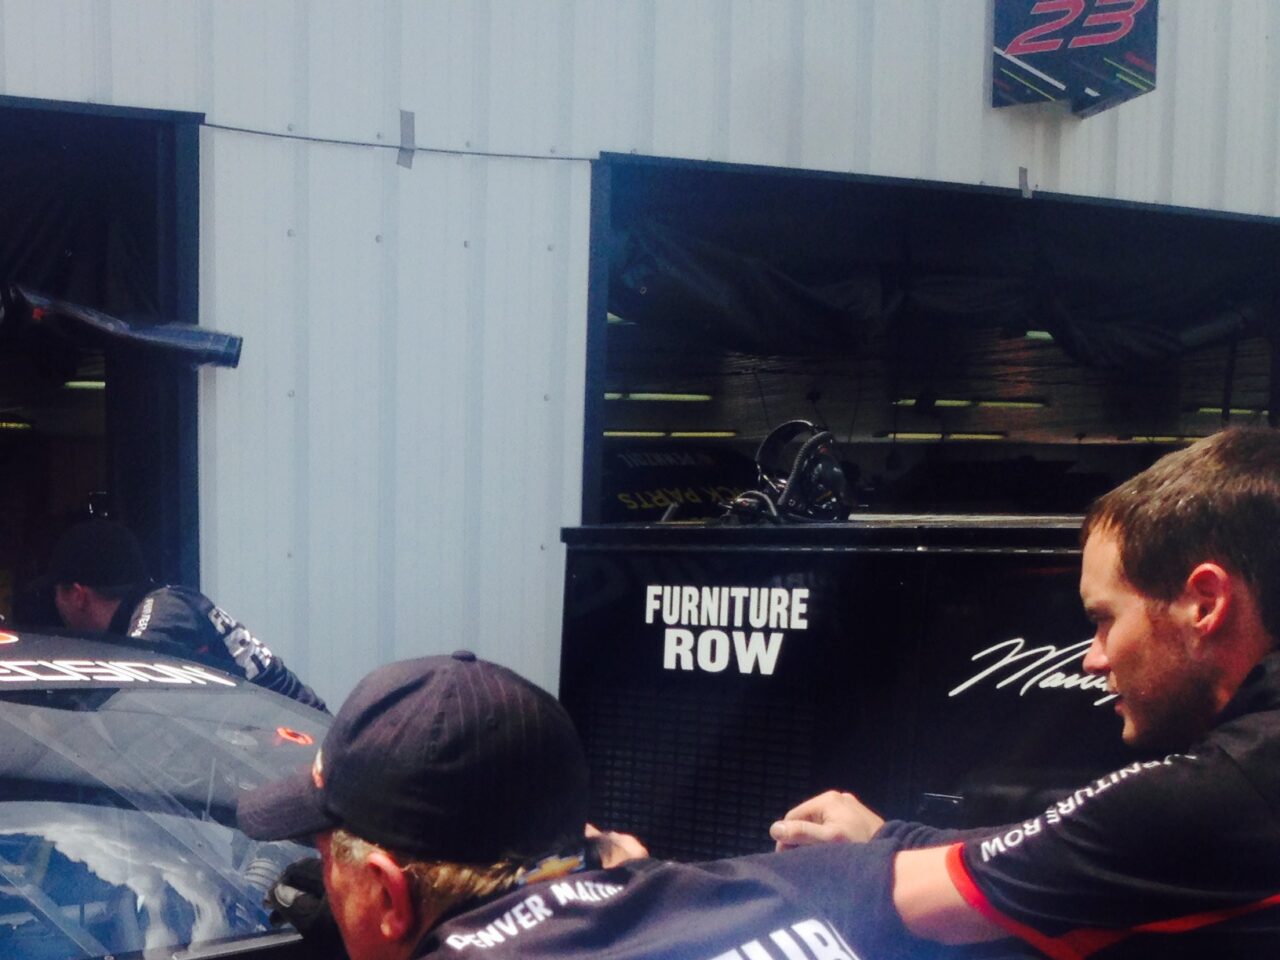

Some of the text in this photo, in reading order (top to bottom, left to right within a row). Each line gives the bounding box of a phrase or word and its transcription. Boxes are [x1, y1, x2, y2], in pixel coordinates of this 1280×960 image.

[1004, 0, 1148, 56] 23
[645, 584, 810, 631] FURNITURE
[662, 628, 785, 676] ROW
[980, 817, 1043, 863] ROW
[446, 894, 554, 951] DENVER
